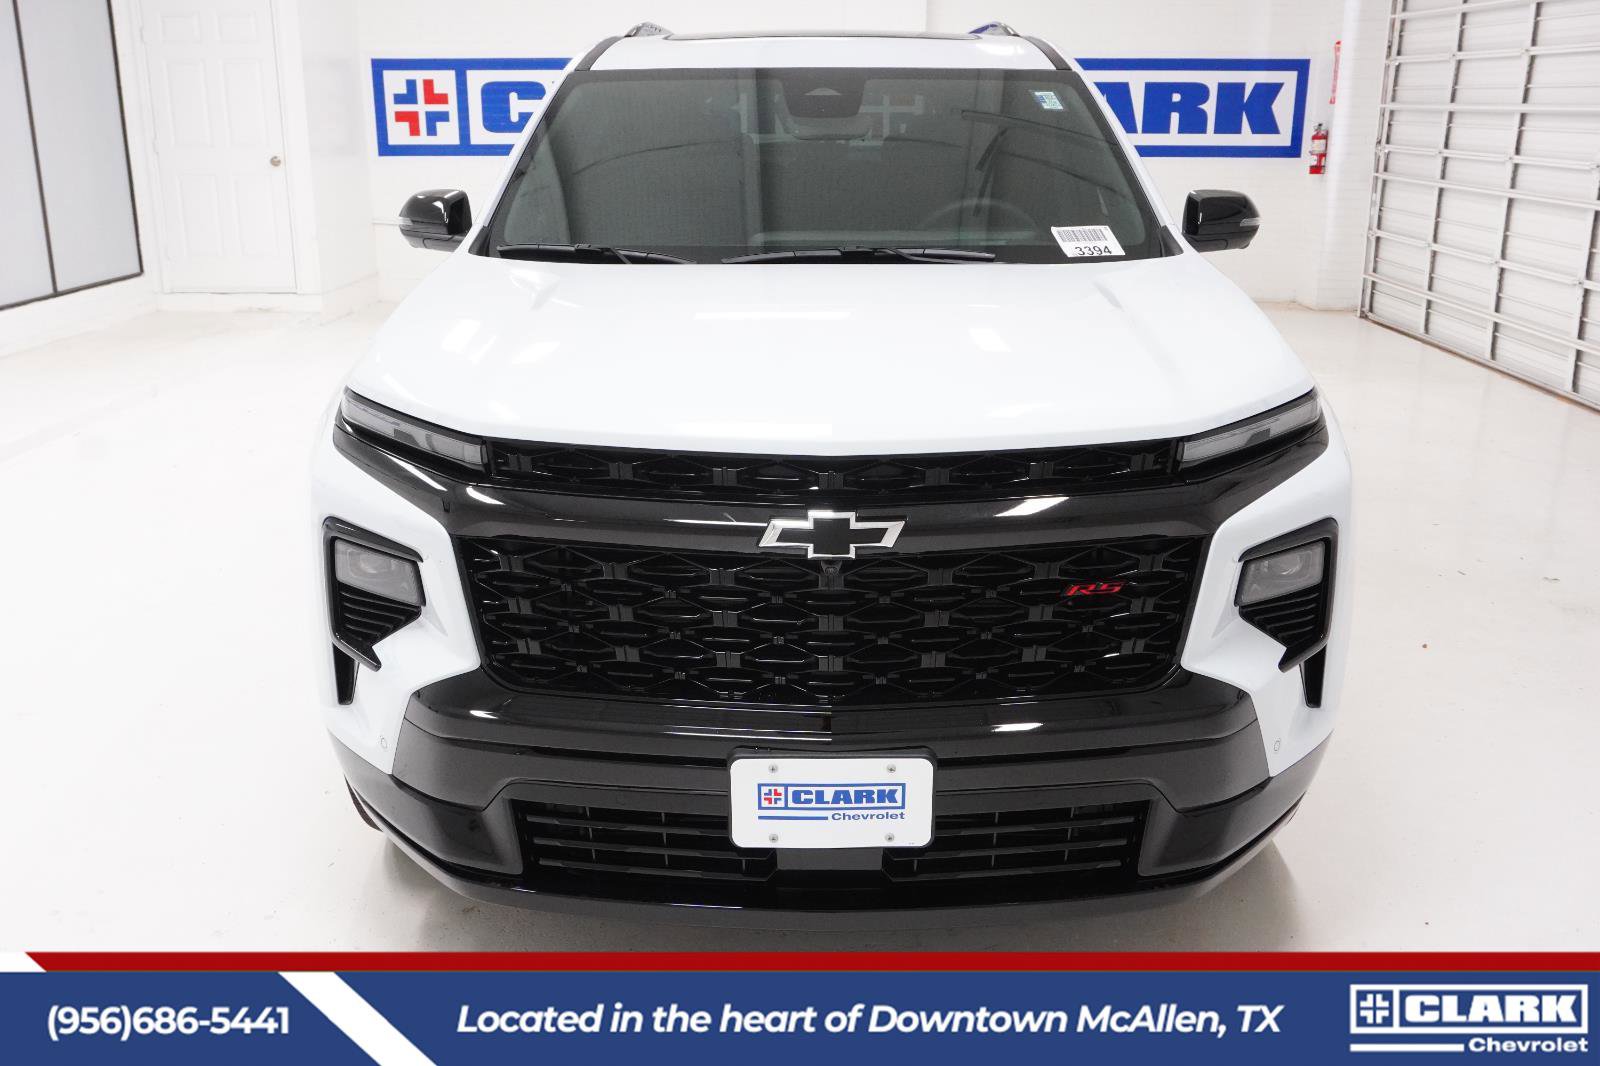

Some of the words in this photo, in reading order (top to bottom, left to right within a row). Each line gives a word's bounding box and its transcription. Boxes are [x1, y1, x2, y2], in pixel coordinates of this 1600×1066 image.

[1074, 245, 1112, 256] 3394
[1065, 582, 1123, 597] RS
[791, 789, 899, 805] CLARK
[831, 811, 906, 821] Chevrolet
